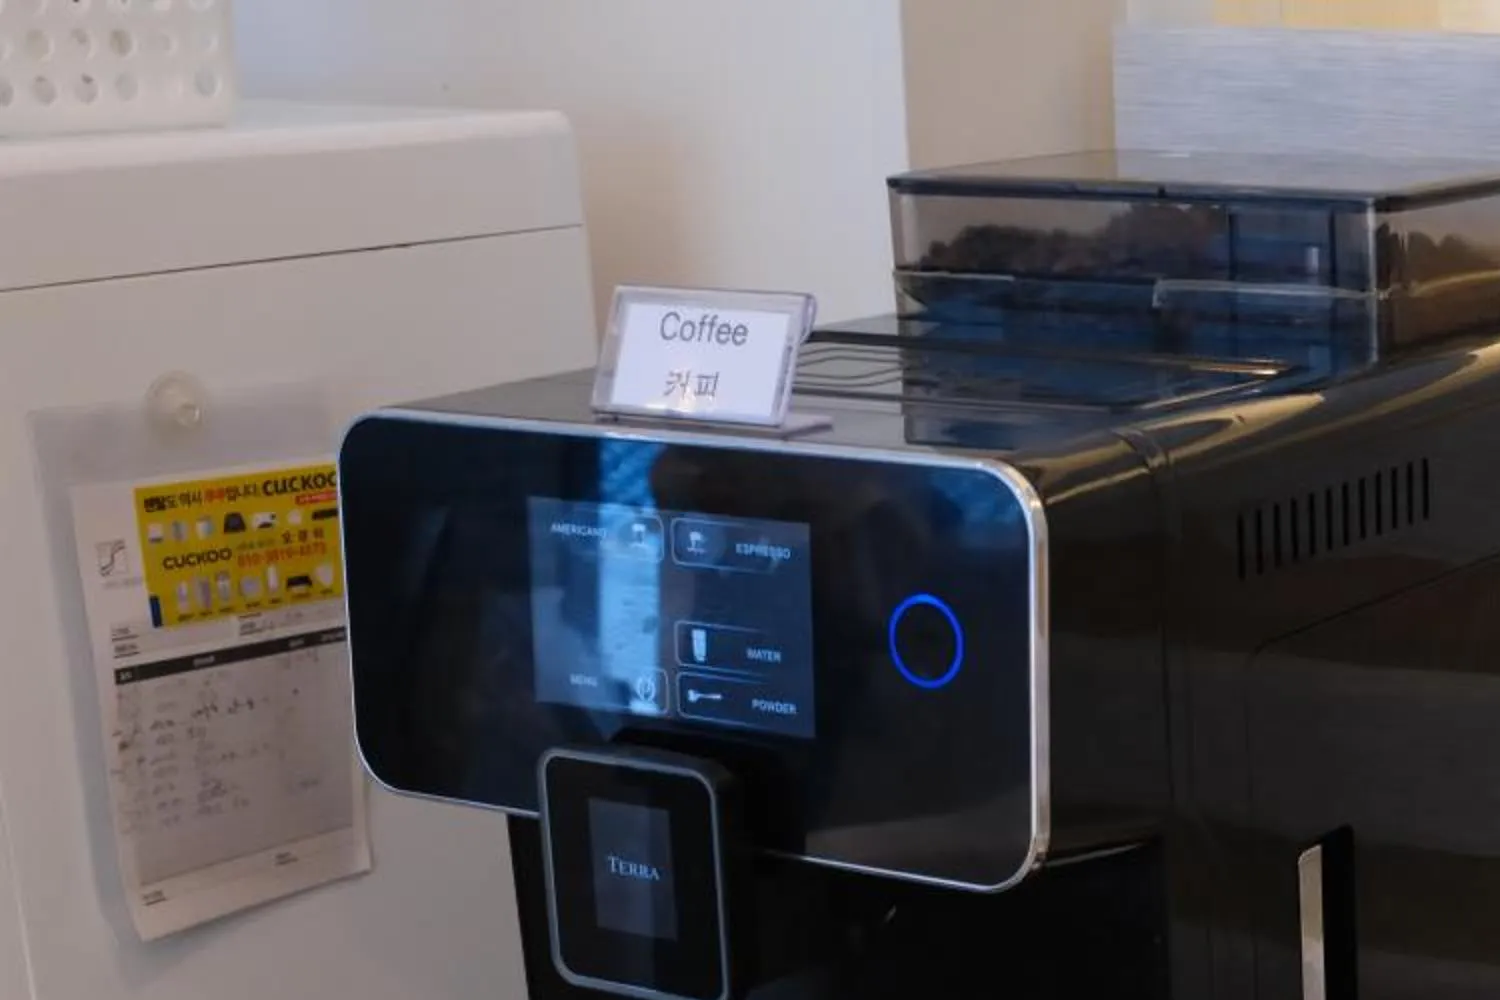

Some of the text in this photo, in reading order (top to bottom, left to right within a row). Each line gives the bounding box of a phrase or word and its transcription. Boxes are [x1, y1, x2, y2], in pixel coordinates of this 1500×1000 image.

[660, 311, 749, 346] Coffee
[663, 370, 721, 400] 커피
[551, 522, 607, 540] AMERICANO
[163, 547, 233, 571] CUCKOO
[735, 542, 791, 560] ESPRESSO
[746, 647, 782, 663] WATER
[570, 673, 598, 687] MENU
[751, 698, 797, 715] POWDER
